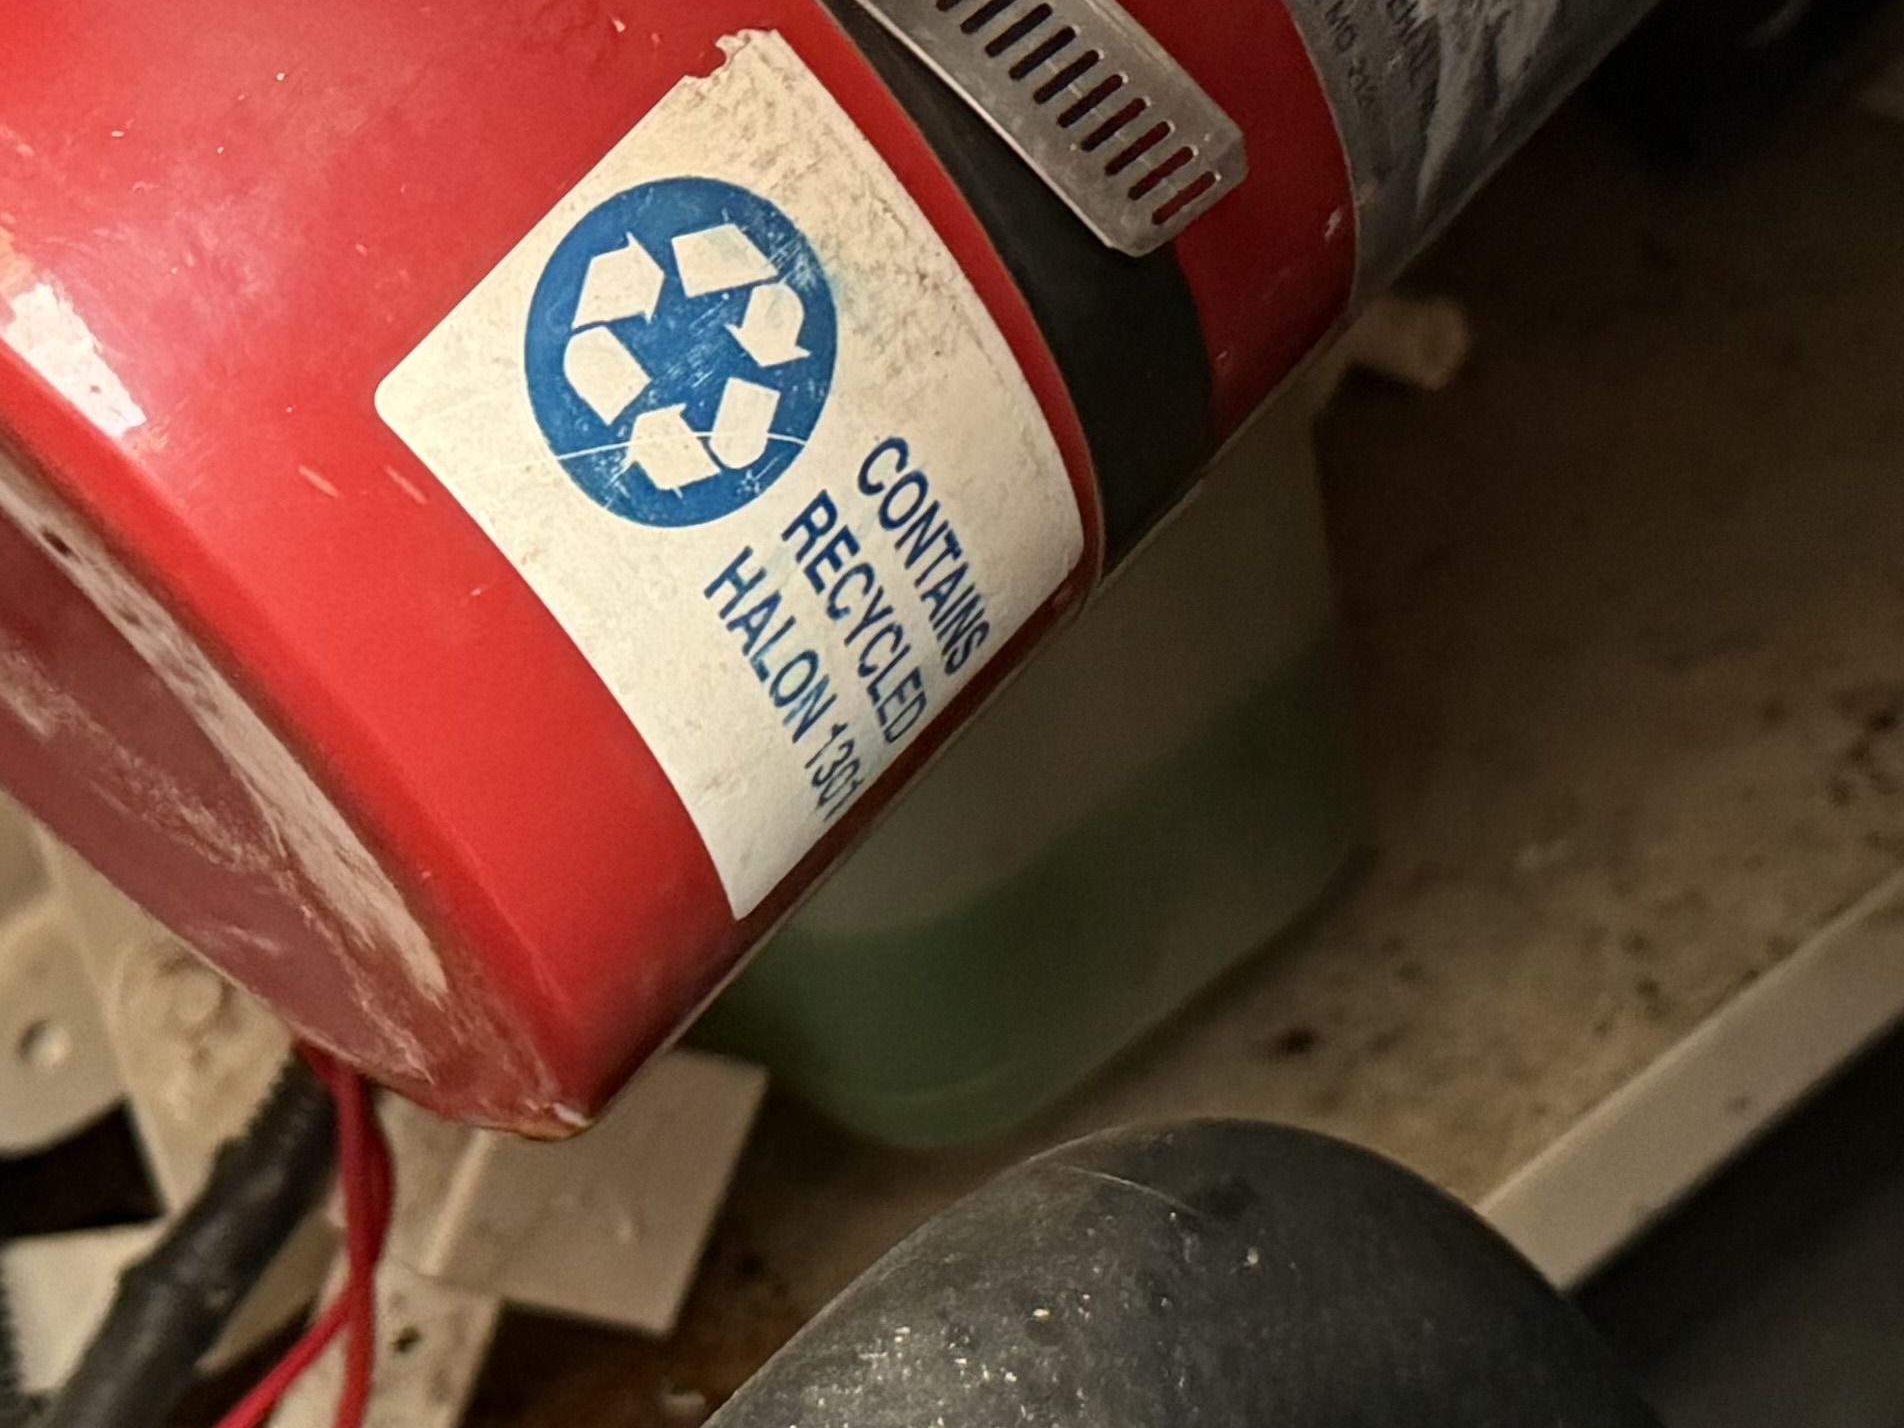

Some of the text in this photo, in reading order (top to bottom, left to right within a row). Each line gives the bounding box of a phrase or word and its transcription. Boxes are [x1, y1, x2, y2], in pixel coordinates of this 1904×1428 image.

[703, 546, 862, 820] HALON 1301
[781, 487, 930, 744] RECYCLED
[855, 434, 989, 678] CONTAINS
